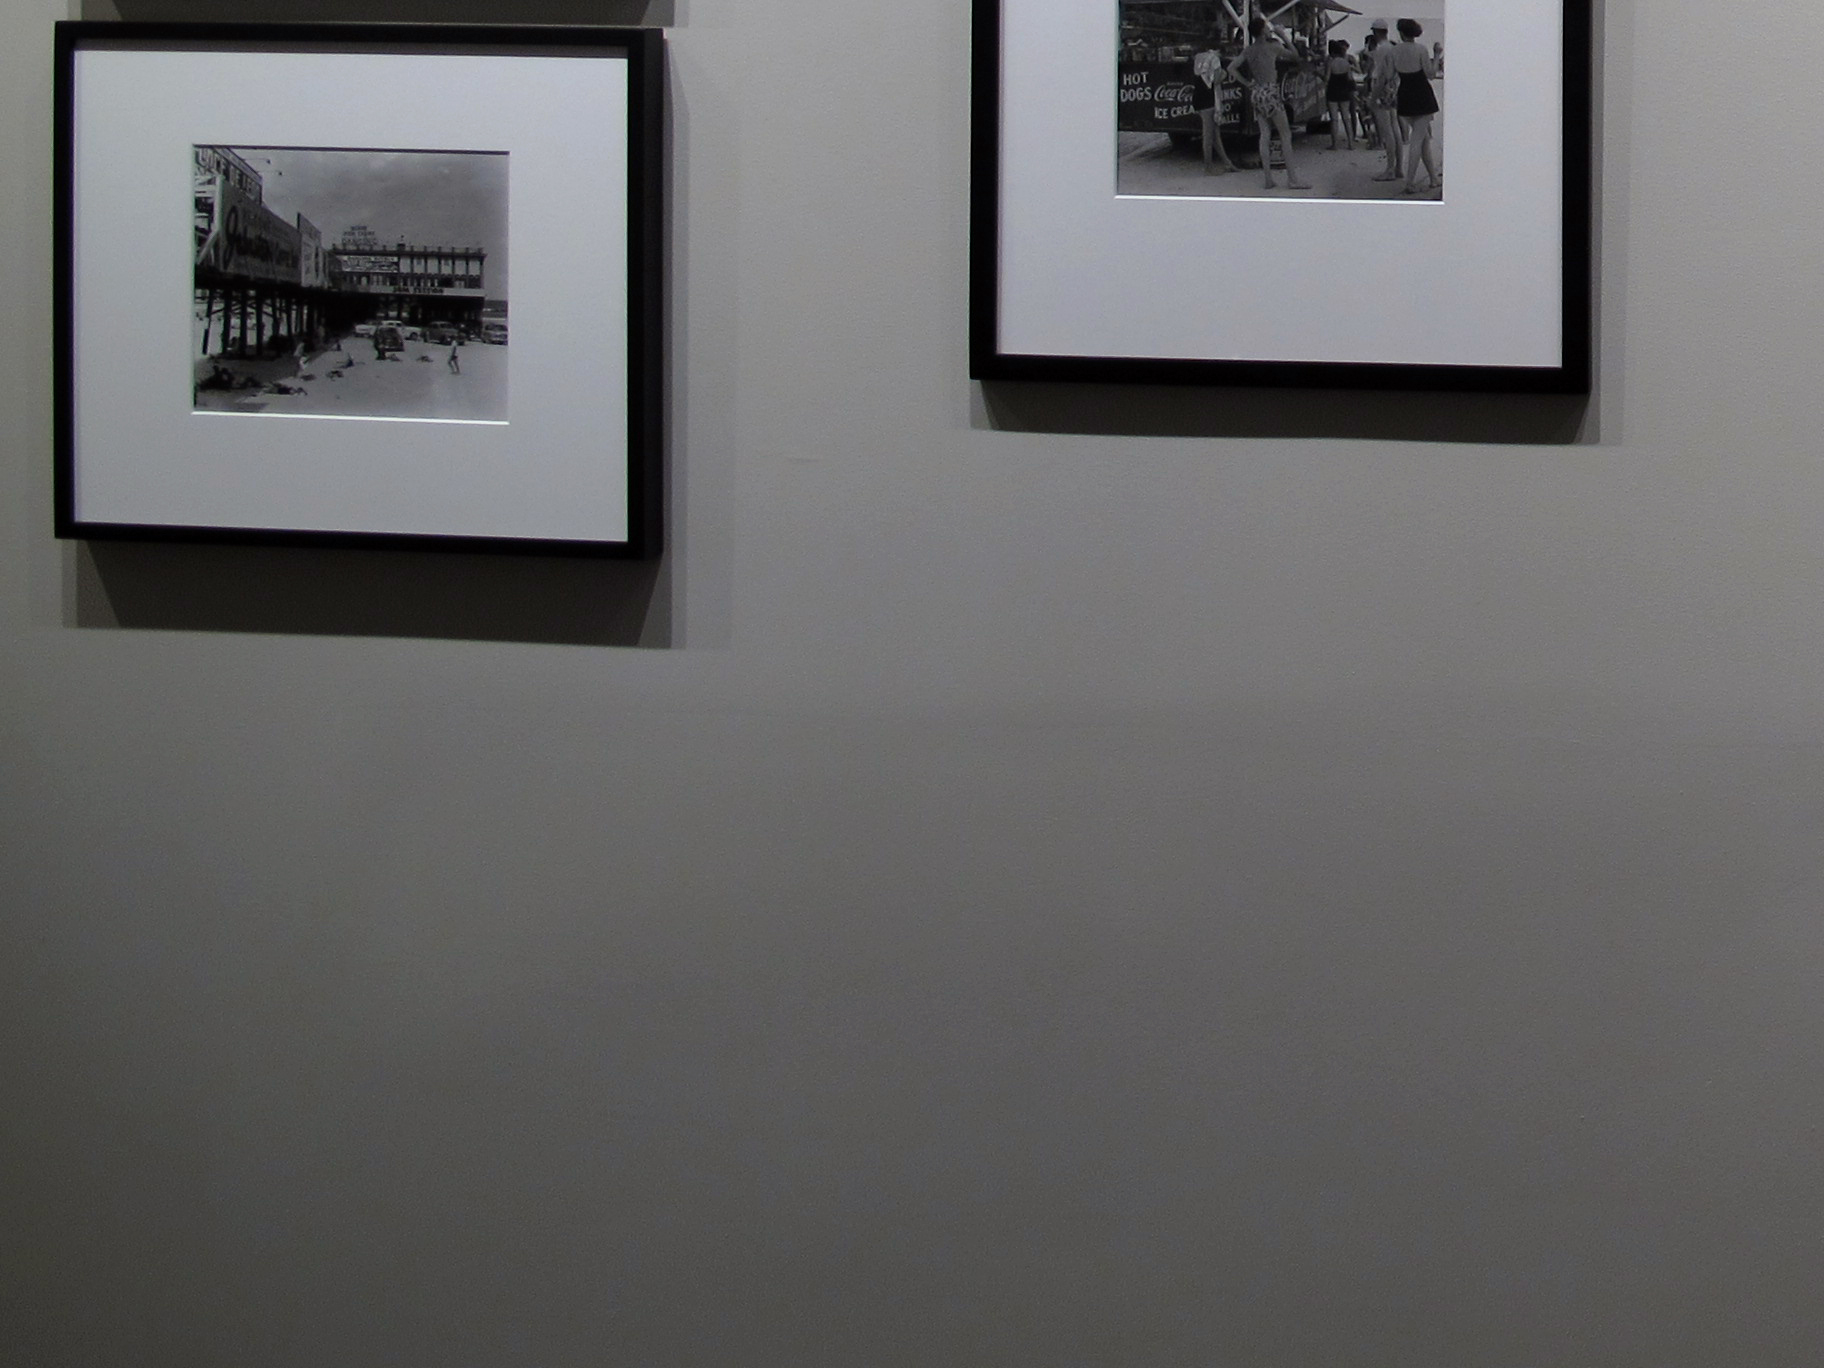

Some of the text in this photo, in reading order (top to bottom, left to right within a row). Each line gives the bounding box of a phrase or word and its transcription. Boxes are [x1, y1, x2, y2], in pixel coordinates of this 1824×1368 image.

[1123, 72, 1149, 85] HOT
[1120, 87, 1152, 102] DOGS
[1154, 105, 1195, 119] ICE CREA
